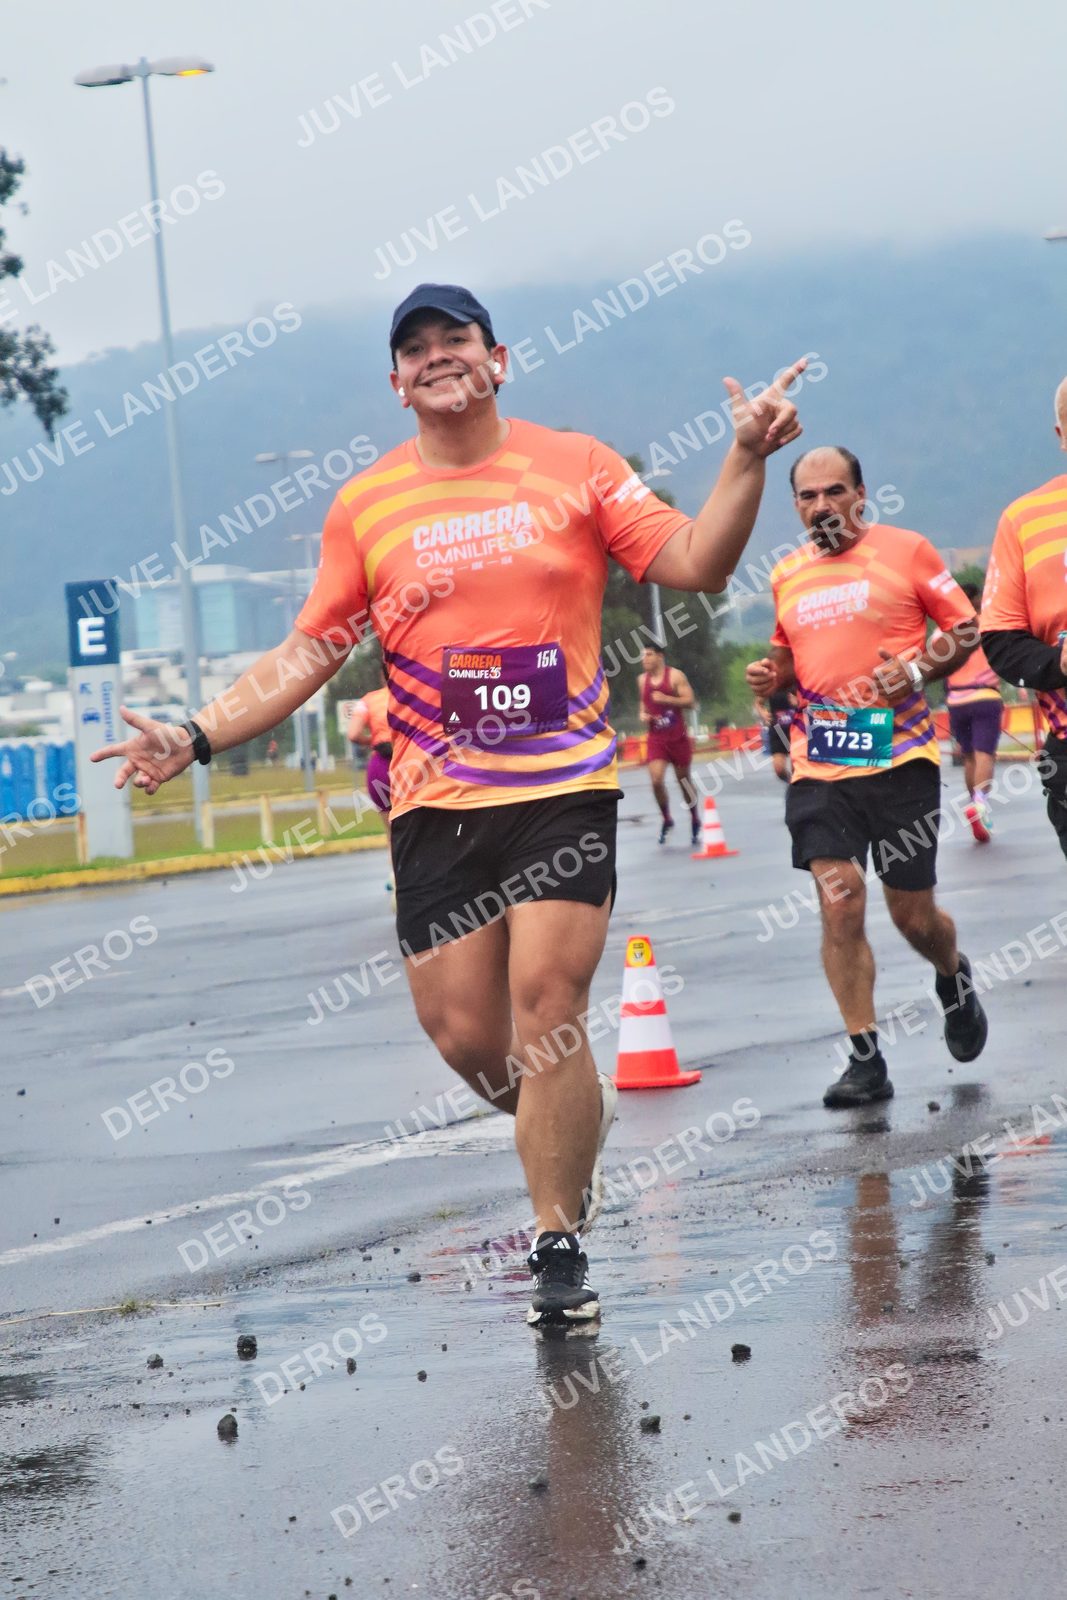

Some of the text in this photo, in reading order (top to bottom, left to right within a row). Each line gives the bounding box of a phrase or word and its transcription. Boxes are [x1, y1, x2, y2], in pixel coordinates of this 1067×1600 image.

[412, 501, 532, 550] CARRERA
[78, 616, 107, 656] E
[449, 649, 558, 669] CARRERA 15K
[474, 684, 531, 711] 109
[824, 730, 873, 750] 1723
